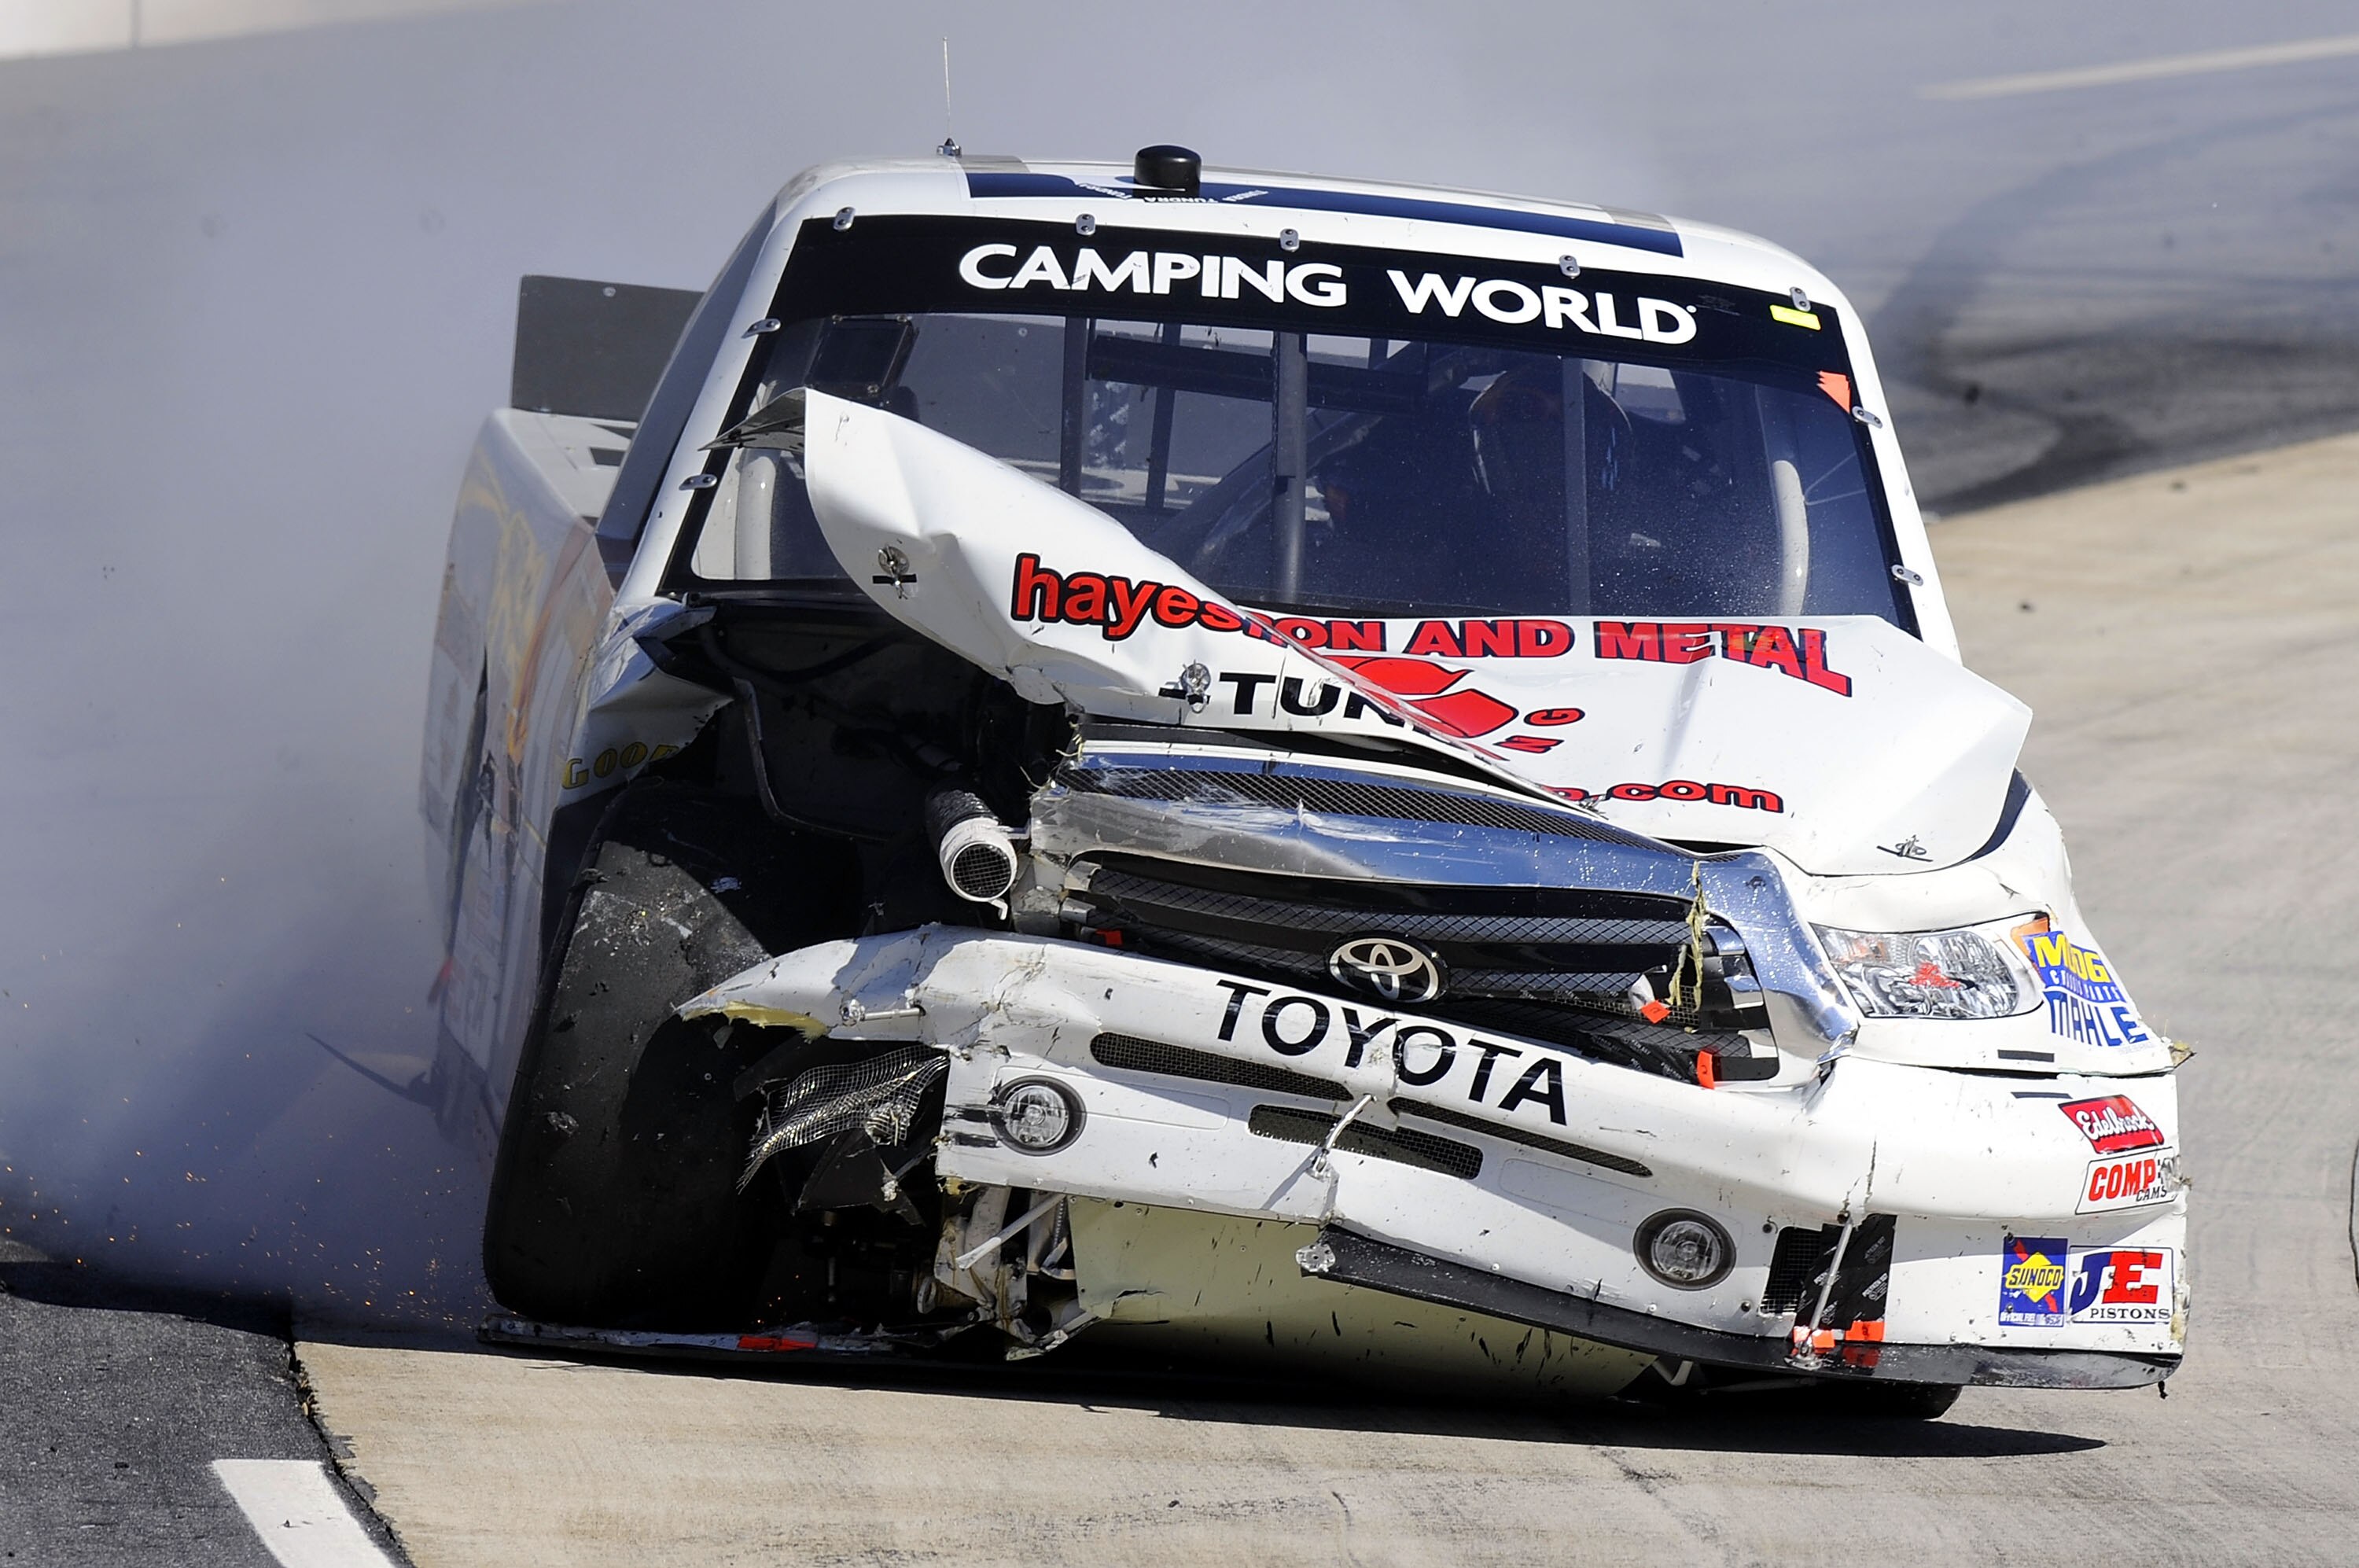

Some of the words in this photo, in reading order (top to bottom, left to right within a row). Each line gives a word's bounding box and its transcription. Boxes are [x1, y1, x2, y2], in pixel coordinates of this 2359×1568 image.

[959, 244, 1347, 307] CAMPING
[1387, 269, 1697, 344] WORLD
[1010, 553, 1244, 641] hayes
[1402, 619, 1575, 658] AND
[1593, 620, 1852, 698] METAL
[2043, 991, 2149, 1047] MAHLE
[1217, 980, 1568, 1127] TOYOTA
[2076, 1106, 2155, 1140] Edelbrock
[2089, 1158, 2156, 1202] COMP
[2136, 1186, 2167, 1202] CAMS
[2008, 1268, 2062, 1286] SUNOCO
[2069, 1250, 2163, 1316] JE
[2090, 1308, 2170, 1320] PISTONS
